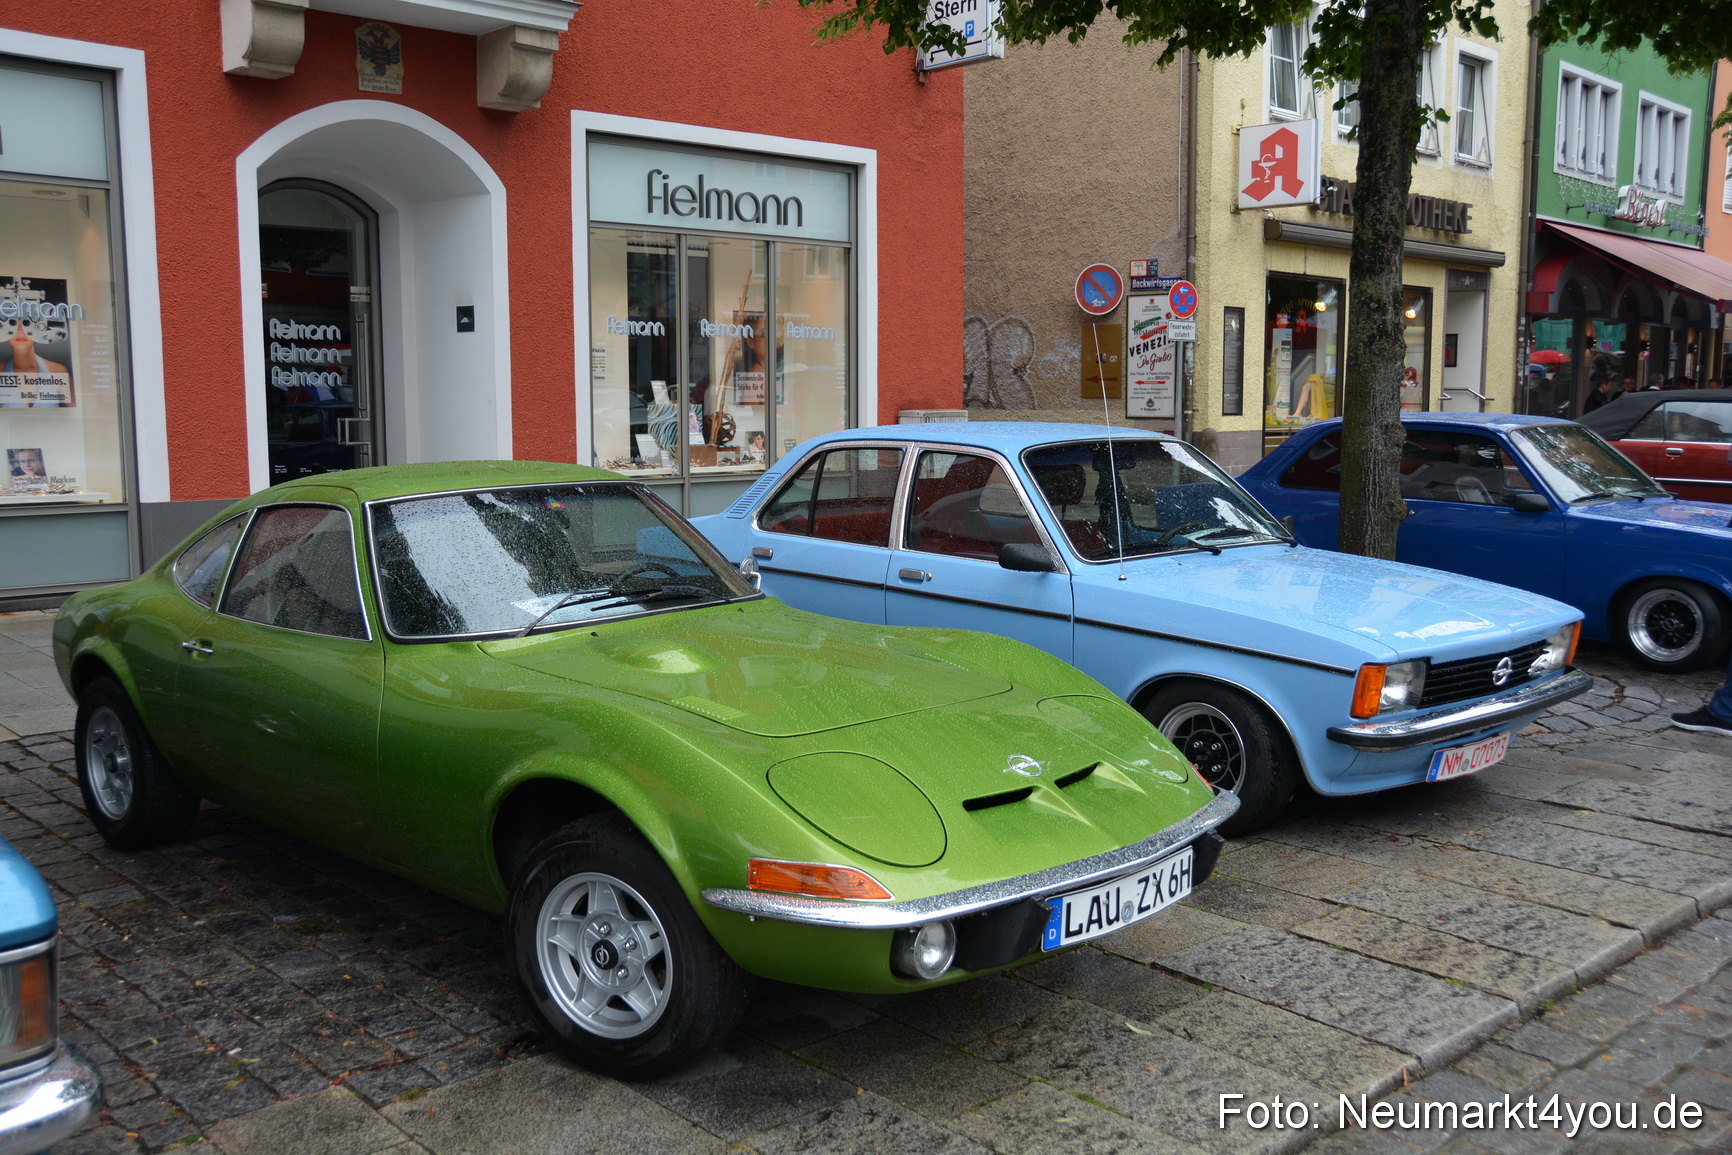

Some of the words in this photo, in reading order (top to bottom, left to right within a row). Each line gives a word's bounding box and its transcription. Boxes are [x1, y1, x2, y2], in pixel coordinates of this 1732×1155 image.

[935, 0, 977, 19] Stern
[647, 168, 803, 228] fielmann
[1318, 175, 1354, 214] STA
[1132, 278, 1181, 289] Bockwirtsgass
[1133, 328, 1168, 336] Restauran
[1170, 323, 1194, 331] Feuerwehr-
[1174, 331, 1190, 339] zufahrt
[1129, 335, 1174, 357] VENEZI
[25, 375, 66, 386] kostenlos.
[737, 373, 764, 382] Sonnenbrille
[737, 383, 751, 391] Stärke
[21, 391, 39, 399] Brille:
[40, 392, 68, 400] Fielmann.
[1441, 751, 1464, 776] NM
[1470, 736, 1507, 769] 07073
[1065, 886, 1121, 939] LAU
[1137, 868, 1164, 915] ZX
[1168, 854, 1191, 898] 6H
[1048, 928, 1057, 941] D
